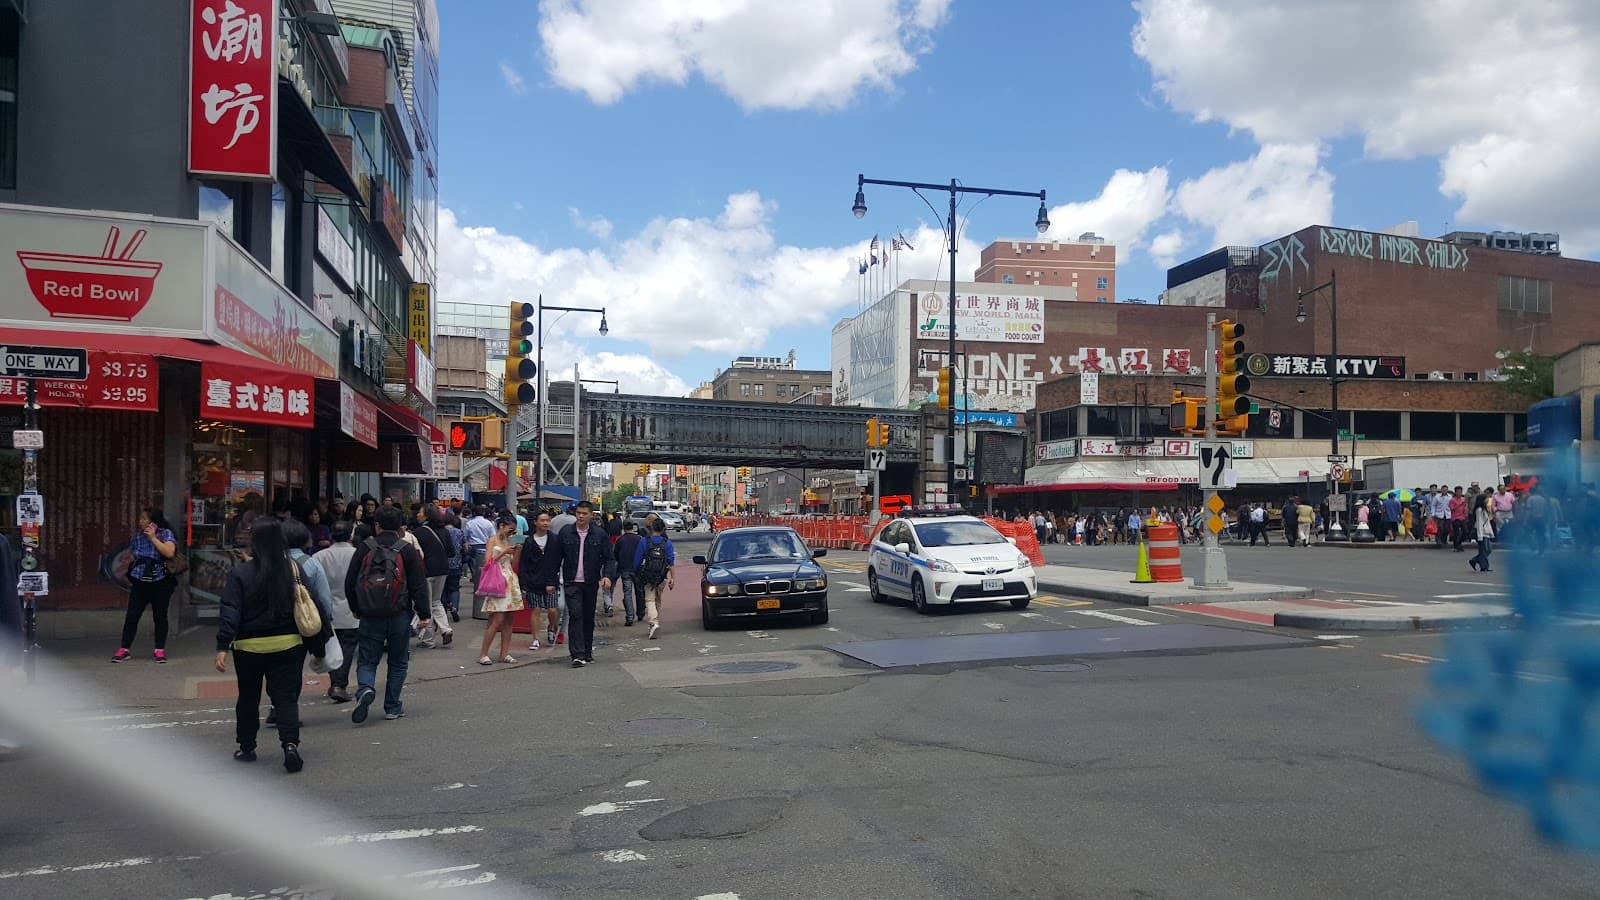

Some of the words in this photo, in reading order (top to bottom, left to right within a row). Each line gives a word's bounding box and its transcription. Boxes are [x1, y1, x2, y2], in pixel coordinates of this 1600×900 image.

[1319, 227, 1374, 260] RESCUE
[1379, 234, 1424, 266] INNER
[43, 280, 83, 298] Red
[90, 282, 139, 302] Bowl
[975, 311, 1010, 319] WORLD
[1004, 332, 1020, 340] FOOD
[1022, 333, 1040, 341] COURT
[5, 354, 36, 368] ONE
[44, 357, 75, 370] WAY
[1273, 356, 1327, 375] 新聚点
[1336, 359, 1377, 376] KTV
[207, 378, 310, 417] 臺式滷味
